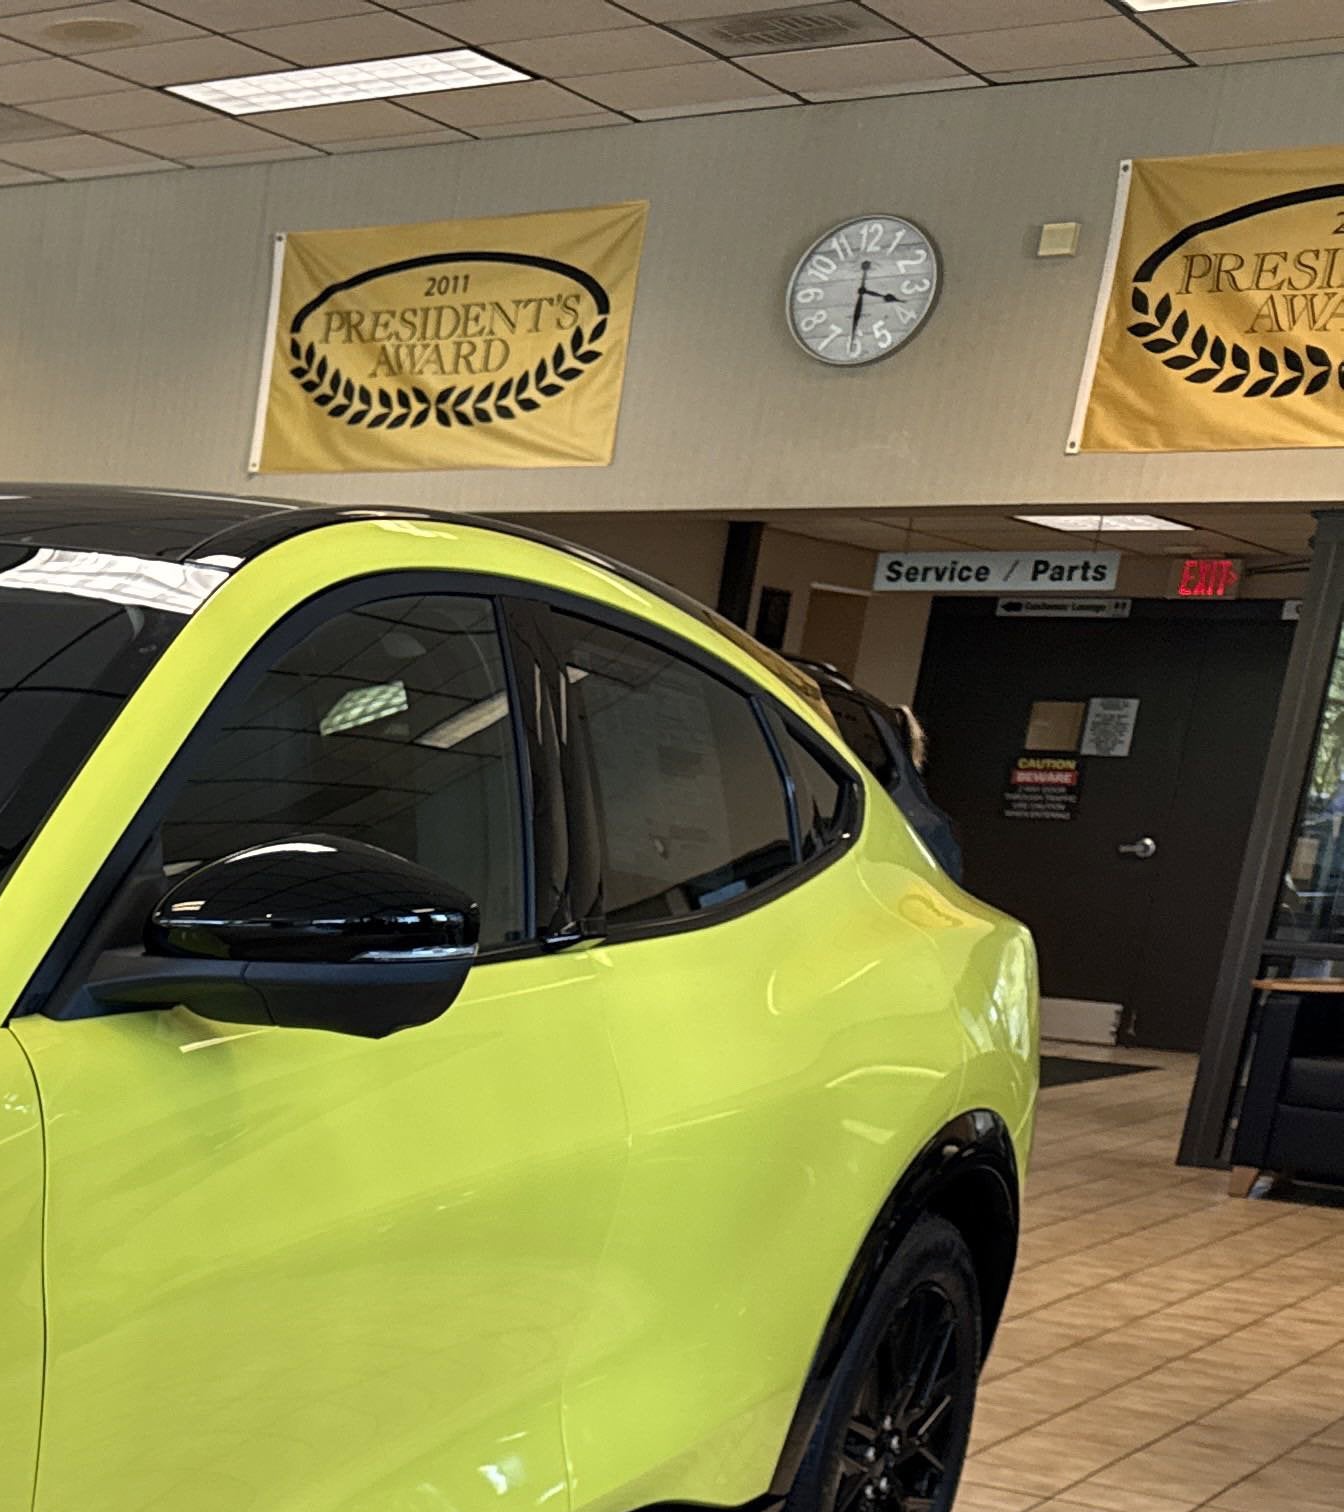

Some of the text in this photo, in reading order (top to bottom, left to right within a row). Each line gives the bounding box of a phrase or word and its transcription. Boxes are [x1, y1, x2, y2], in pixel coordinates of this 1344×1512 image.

[830, 232, 854, 261] 11
[860, 223, 884, 253] 12
[886, 228, 906, 256] 1
[807, 254, 837, 281] 10
[896, 249, 928, 274] 2
[424, 274, 470, 297] 2011
[796, 287, 825, 303] 9
[900, 278, 931, 295] 3
[319, 293, 582, 345] PRESIDENT'S
[800, 309, 827, 332] 8
[893, 302, 918, 325] 4
[818, 323, 843, 351] 7
[872, 320, 892, 349] 5
[368, 336, 510, 378] AWARD
[884, 559, 1108, 583] Service / Parts
[1178, 559, 1233, 596] EXIT
[1015, 770, 1073, 783] BEWARE
[1017, 757, 1077, 770] CAUTION
